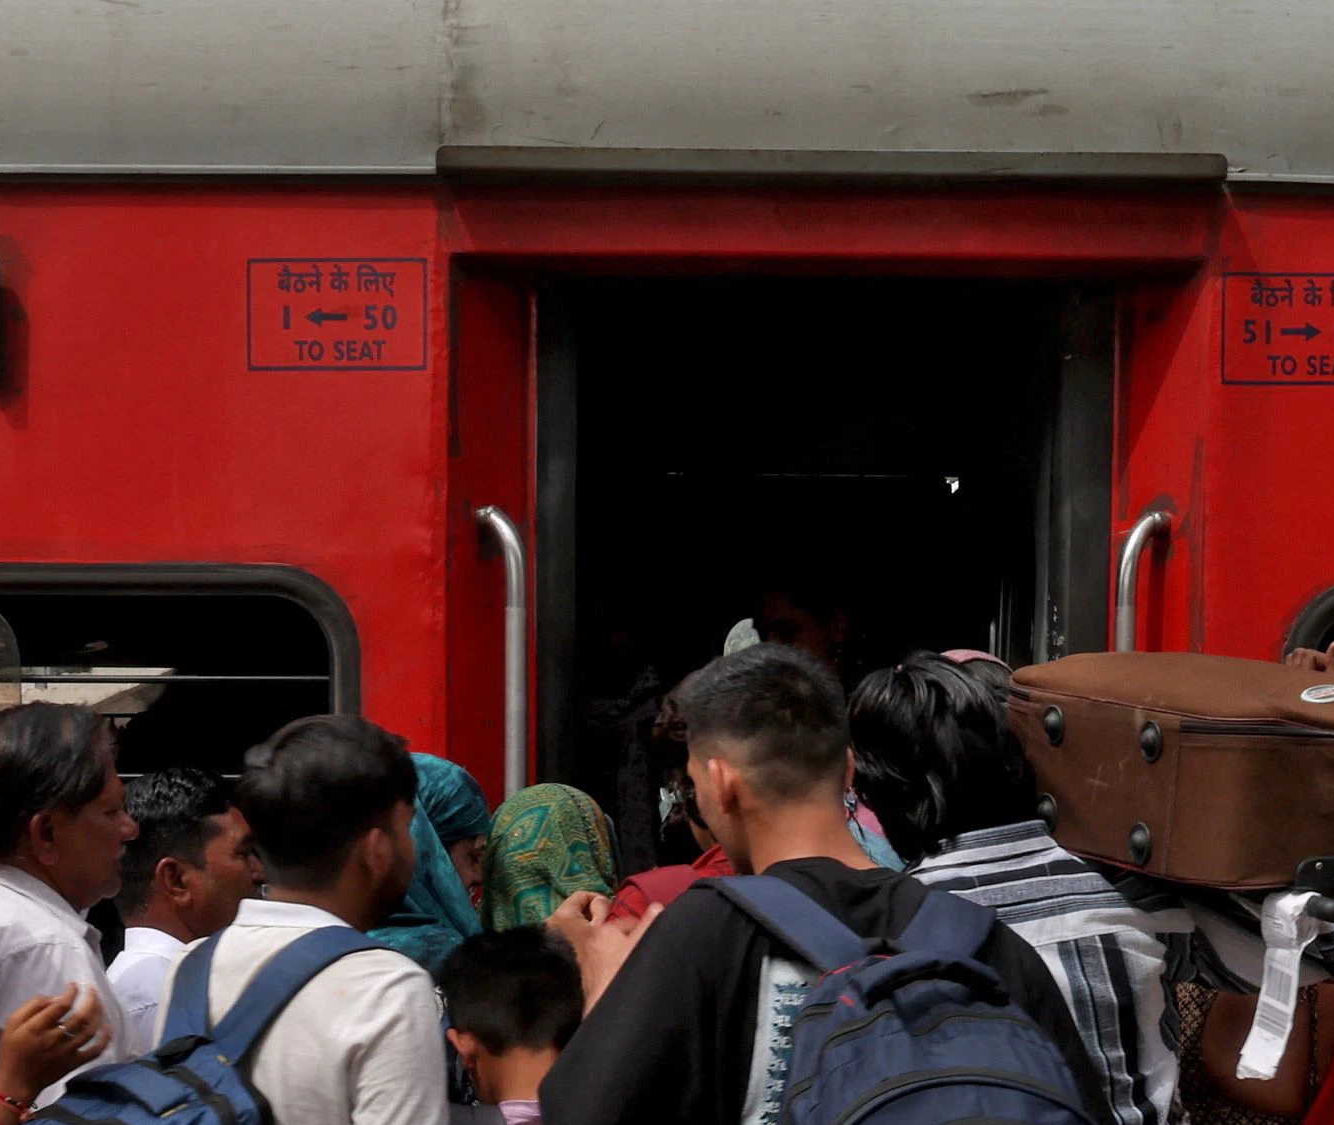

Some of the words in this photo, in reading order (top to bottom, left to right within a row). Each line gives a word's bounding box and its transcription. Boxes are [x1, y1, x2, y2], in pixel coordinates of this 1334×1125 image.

[278, 264, 322, 293] बैठने
[330, 264, 350, 293] के
[357, 264, 396, 297] लिए
[1251, 280, 1294, 308] बैठने
[1303, 280, 1323, 307] के
[363, 305, 398, 330] 50
[1243, 320, 1272, 344] 51
[294, 340, 324, 361] TO
[333, 340, 386, 361] SEAT
[1268, 355, 1297, 376] TO
